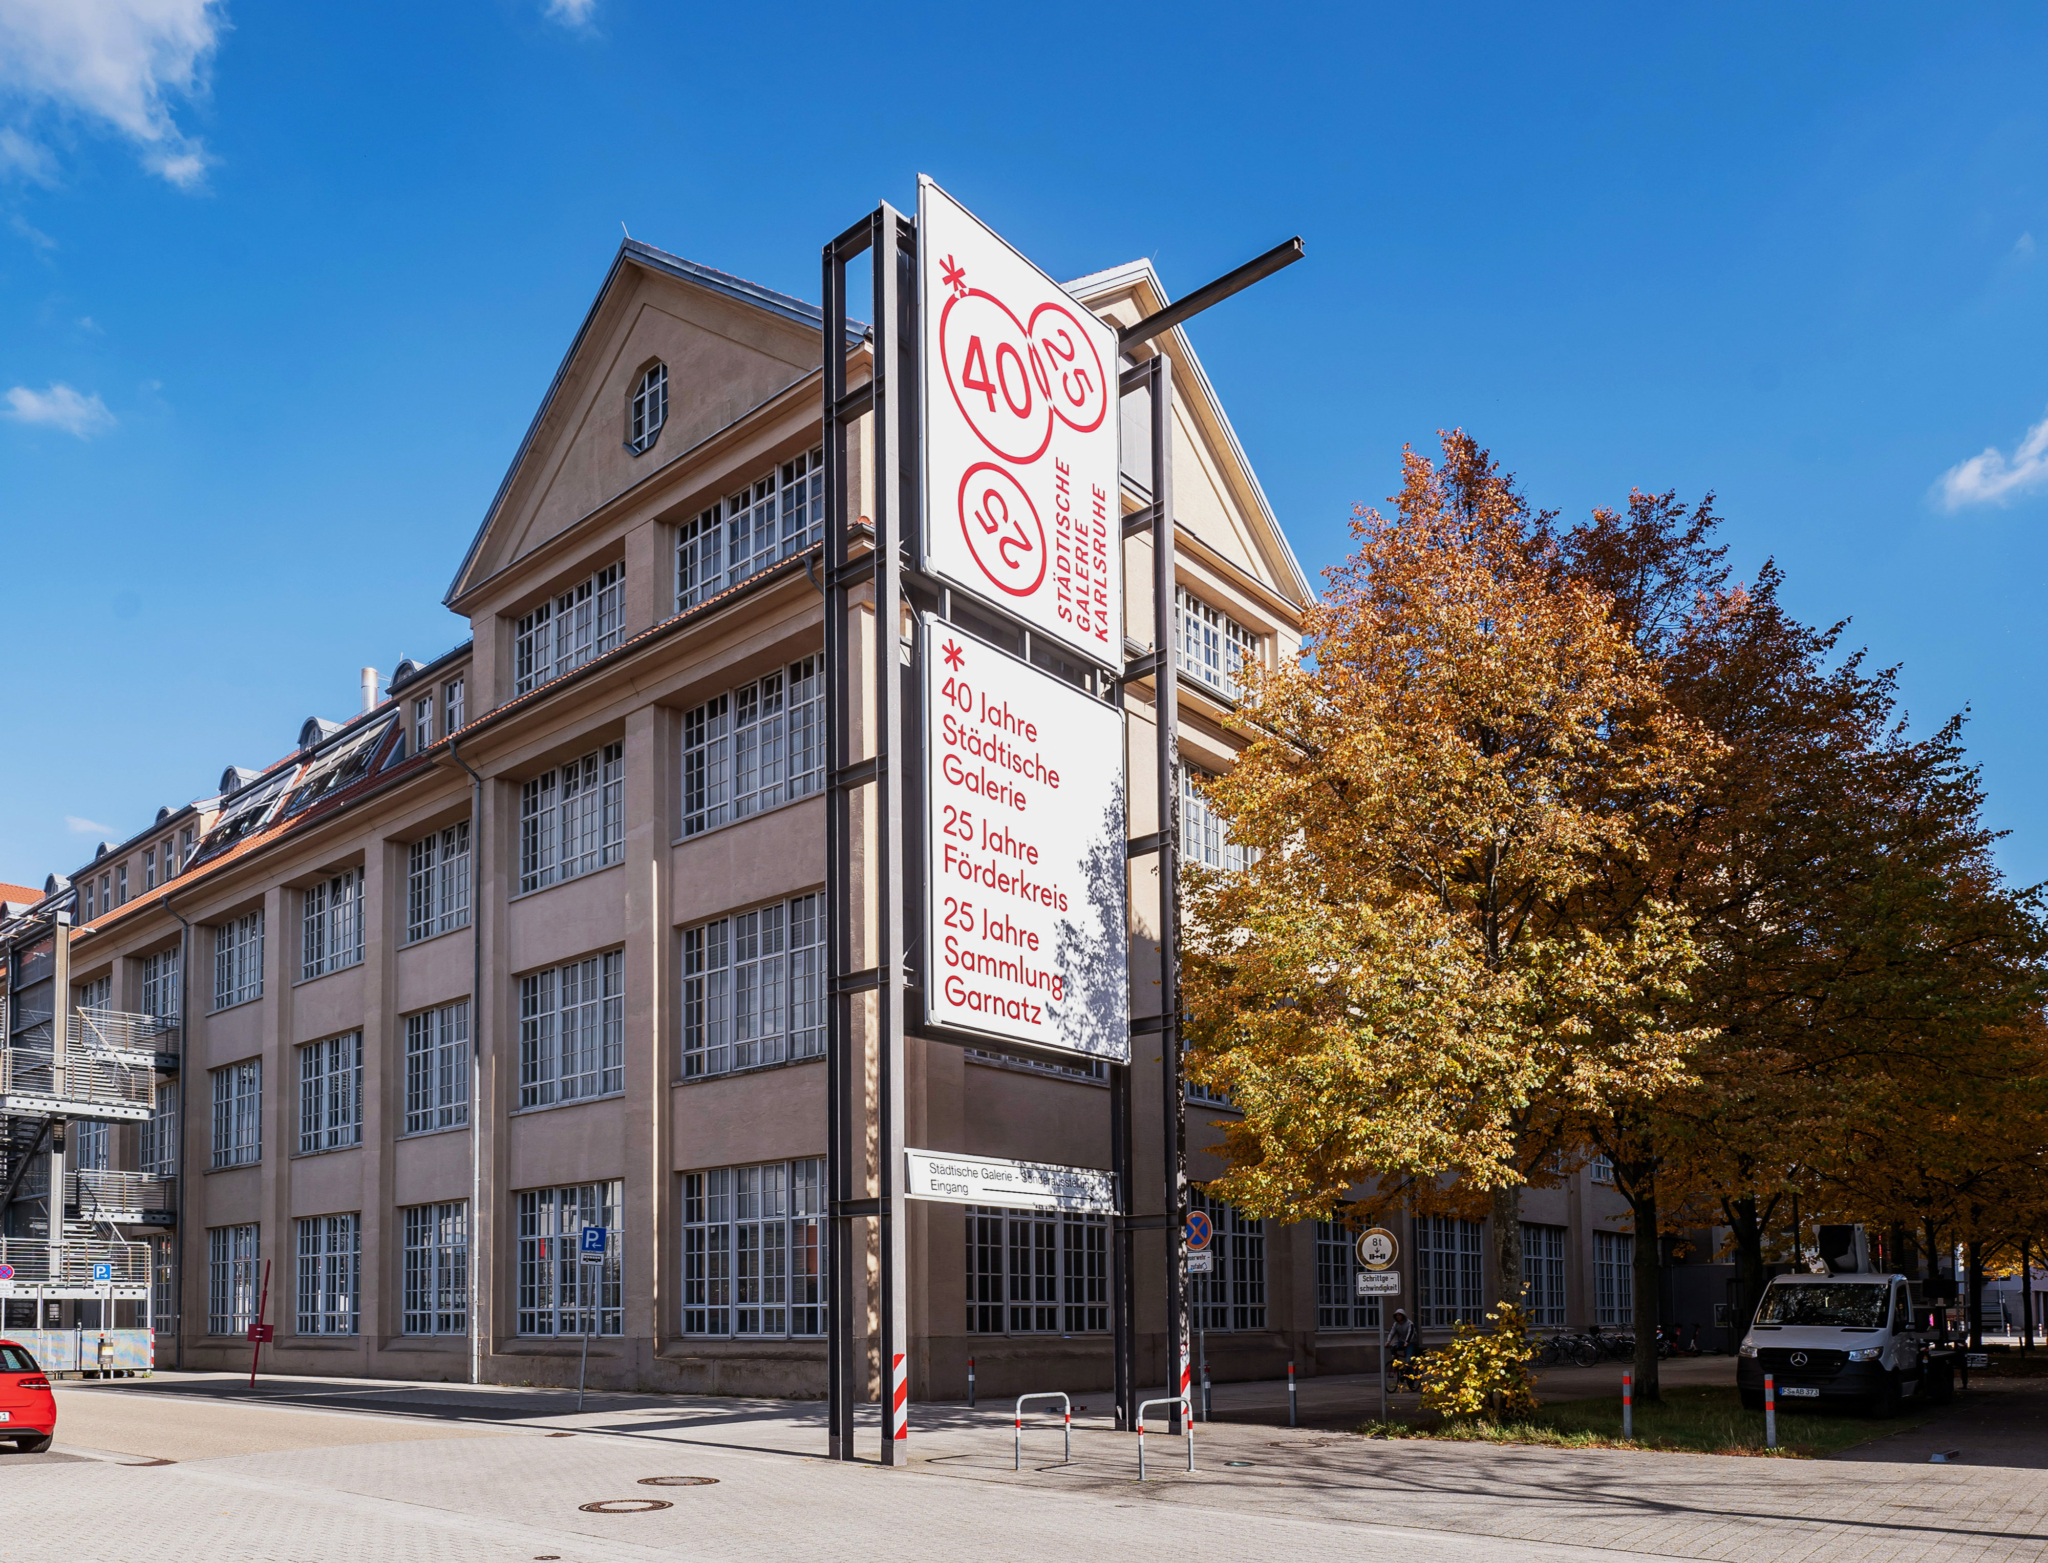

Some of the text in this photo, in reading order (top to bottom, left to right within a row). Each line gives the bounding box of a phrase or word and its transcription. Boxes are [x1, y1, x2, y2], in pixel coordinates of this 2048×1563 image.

[962, 335, 1032, 419] 40
[1042, 329, 1093, 407] 25
[975, 489, 1032, 569] 25
[1053, 457, 1072, 622] STÄDTISCHE
[1075, 519, 1090, 632] GALERIE
[1093, 484, 1108, 642] KARLSRUHE
[942, 678, 1037, 742] 40 Jahre
[943, 714, 1059, 788] Städtische
[943, 754, 1026, 811] Galerie
[943, 805, 1038, 864] 25 Jahre
[944, 844, 1067, 911] Förderkreis
[944, 897, 1038, 951] 25 Jahre
[945, 936, 1063, 1000] Sammlung
[945, 975, 1041, 1024] Garnatz
[929, 1162, 978, 1179] Städtische
[981, 1167, 1012, 1182] Galerie
[930, 1180, 969, 1195] Eingang
[585, 1230, 599, 1248] P
[96, 1267, 106, 1279] P
[1360, 1284, 1397, 1292] schwindigkeit
